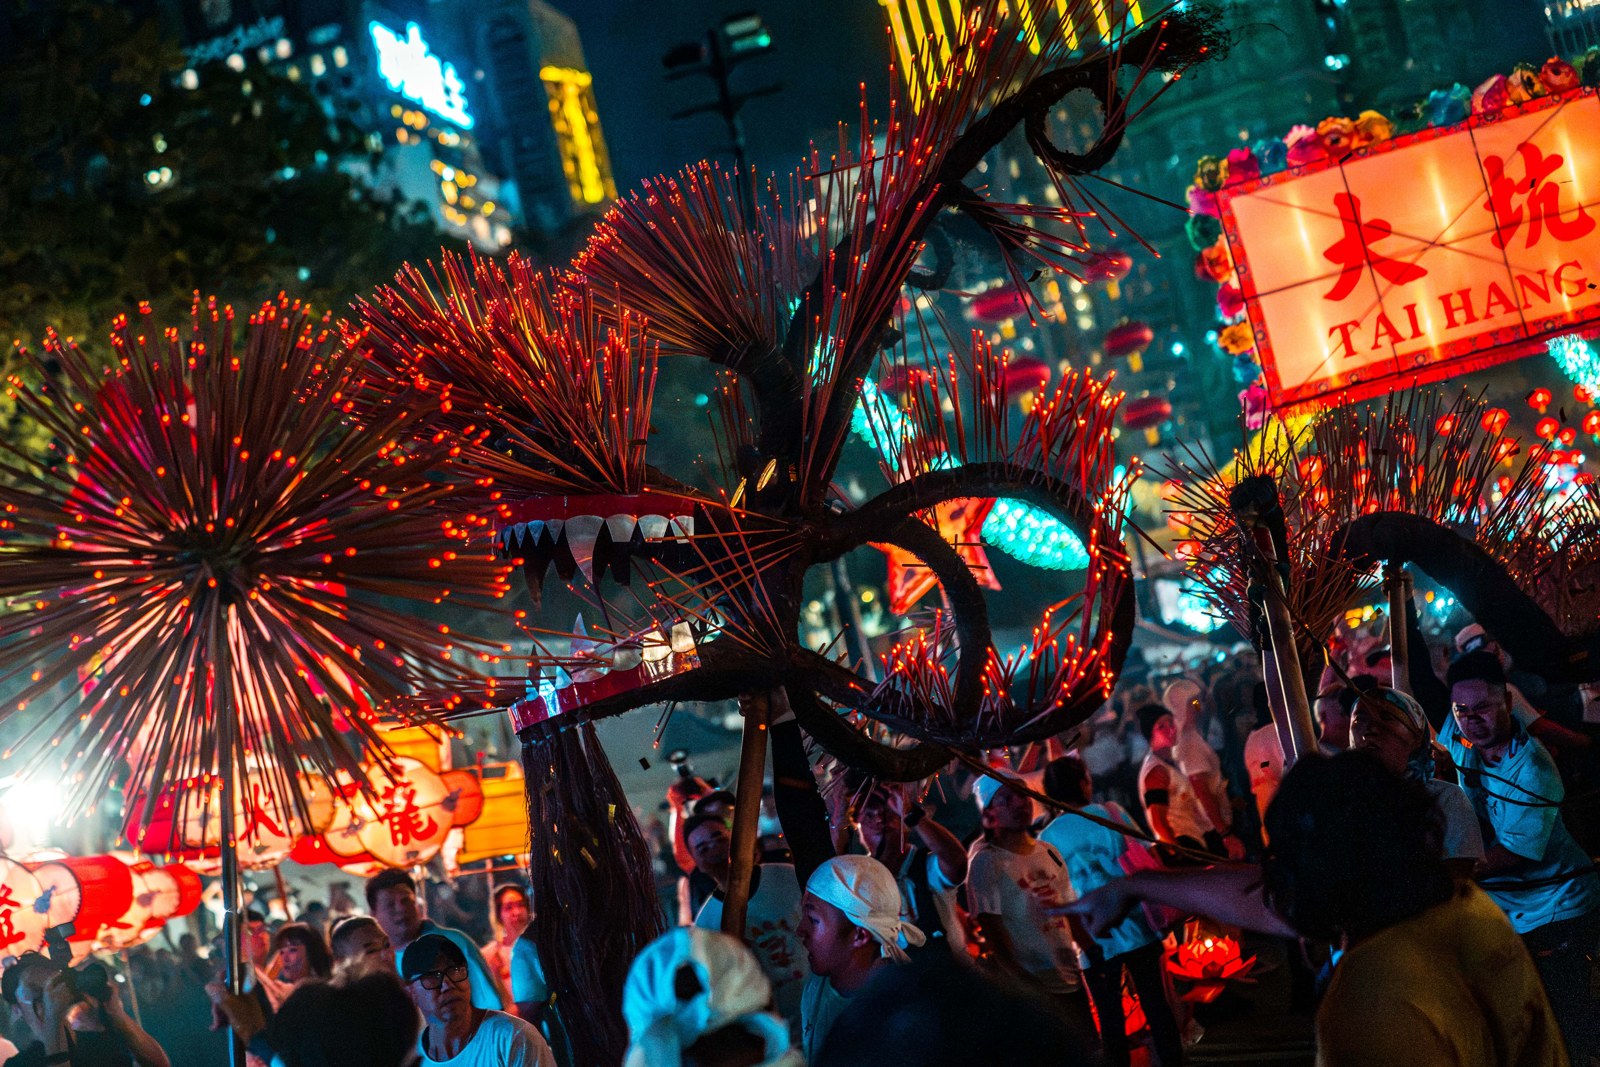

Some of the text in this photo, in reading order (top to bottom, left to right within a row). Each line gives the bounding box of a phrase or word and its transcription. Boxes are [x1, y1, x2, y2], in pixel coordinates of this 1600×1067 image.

[1323, 142, 1597, 302] 大坑
[1328, 259, 1588, 359] TAI HANG
